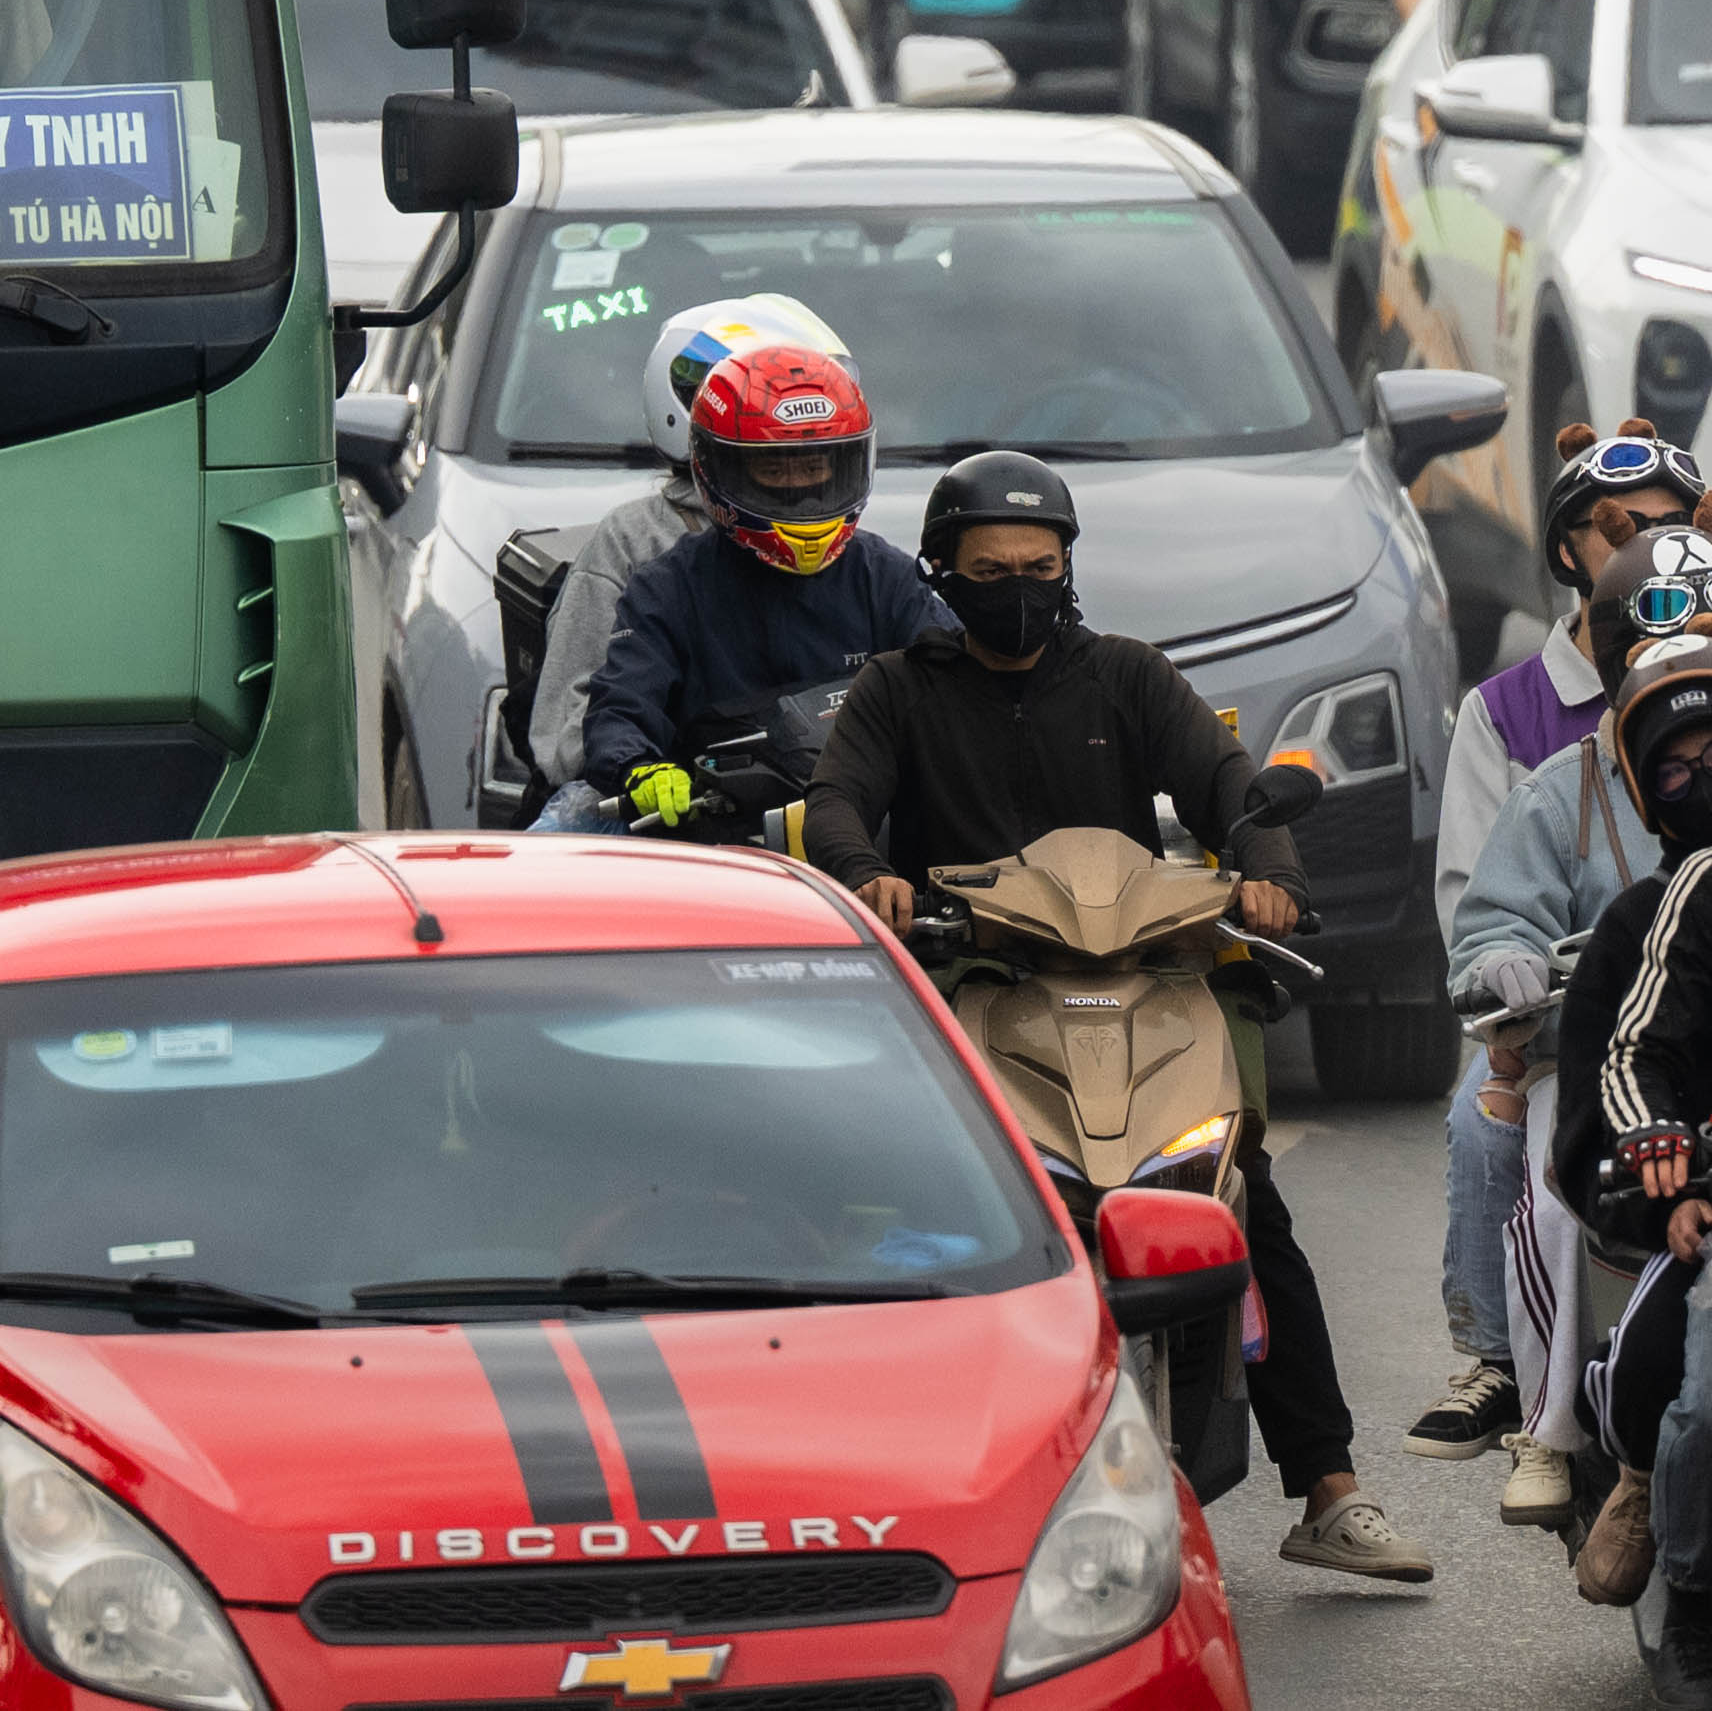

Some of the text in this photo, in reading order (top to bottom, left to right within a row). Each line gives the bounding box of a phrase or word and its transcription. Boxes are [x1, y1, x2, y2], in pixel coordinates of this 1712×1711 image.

[25, 112, 148, 167] TNHH
[9, 198, 50, 243] TÚ
[60, 195, 107, 243] HÀ
[116, 194, 174, 250] NỘI
[542, 285, 649, 332] TAXI
[783, 402, 827, 418] SHOEI
[1063, 997, 1121, 1007] HONDA
[328, 1515, 900, 1564] DISCOVERY
